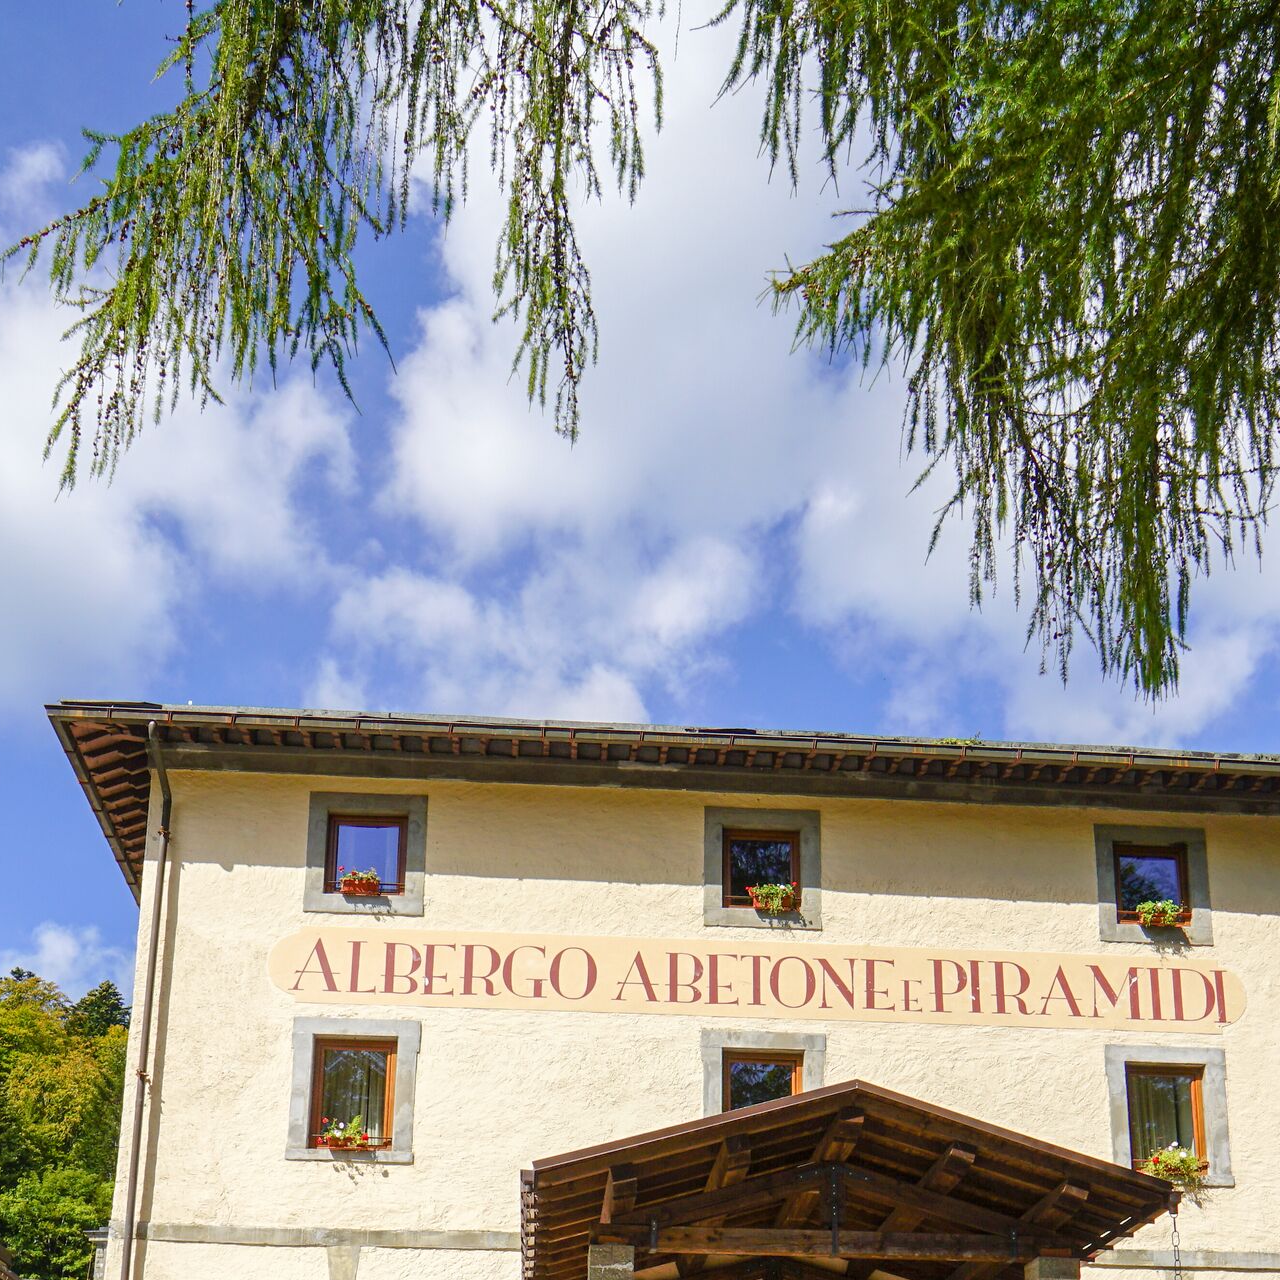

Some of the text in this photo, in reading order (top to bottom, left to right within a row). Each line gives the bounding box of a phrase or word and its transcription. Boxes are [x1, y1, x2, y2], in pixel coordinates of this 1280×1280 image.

[287, 937, 1232, 1024] ALBERGO ABETONE E PIRAMIDI
